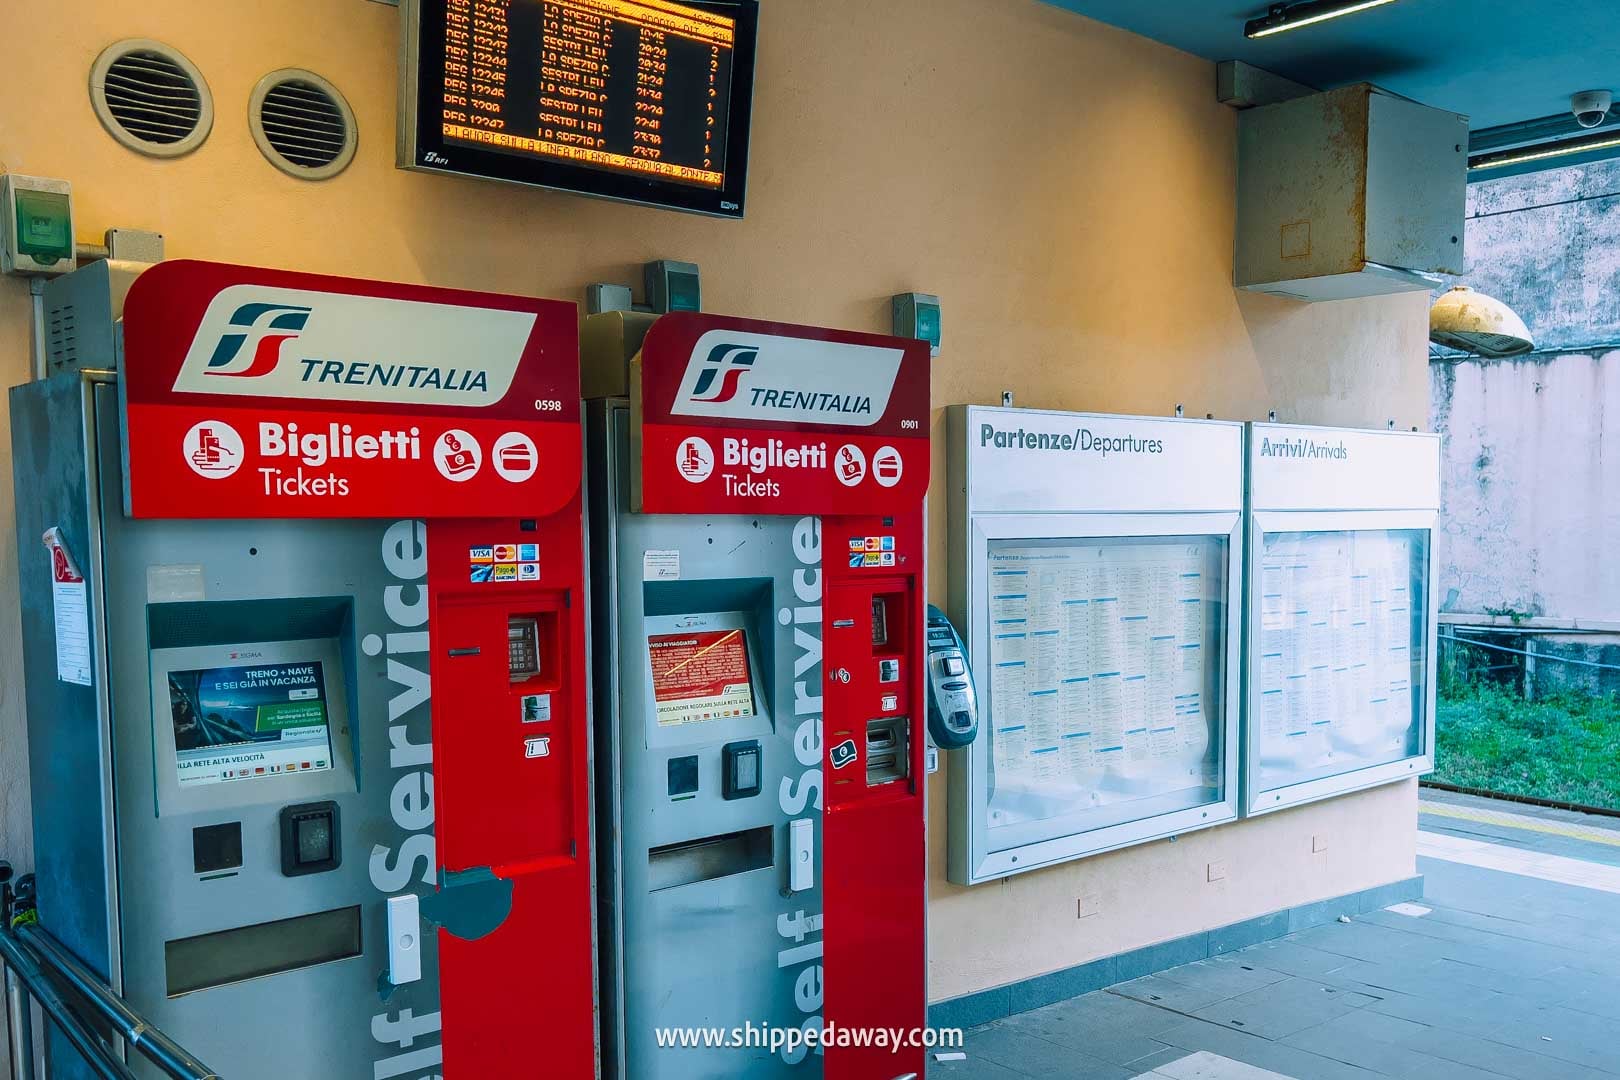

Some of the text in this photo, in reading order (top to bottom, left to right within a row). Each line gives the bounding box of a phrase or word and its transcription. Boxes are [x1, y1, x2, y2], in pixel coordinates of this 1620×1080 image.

[301, 358, 488, 393] TRENITALIA
[535, 399, 562, 412] 0598
[750, 387, 871, 414] TRENITALIA
[901, 419, 919, 429] 0901
[258, 421, 421, 467] Biglietti
[980, 423, 1164, 458] Partenze/Departures
[1260, 437, 1348, 460] Arrivi/Arrivals
[723, 437, 827, 474] Biglietti
[258, 468, 350, 497] Tickets
[722, 474, 780, 497] Tickets
[472, 549, 491, 558] VISA
[245, 669, 279, 679] TRENO
[287, 666, 314, 676] NAVE
[778, 515, 823, 816] Service
[215, 682, 221, 690] E
[223, 681, 238, 690] SEI
[258, 679, 269, 687] IN
[270, 676, 316, 686] VACANZA
[368, 519, 437, 893] Service
